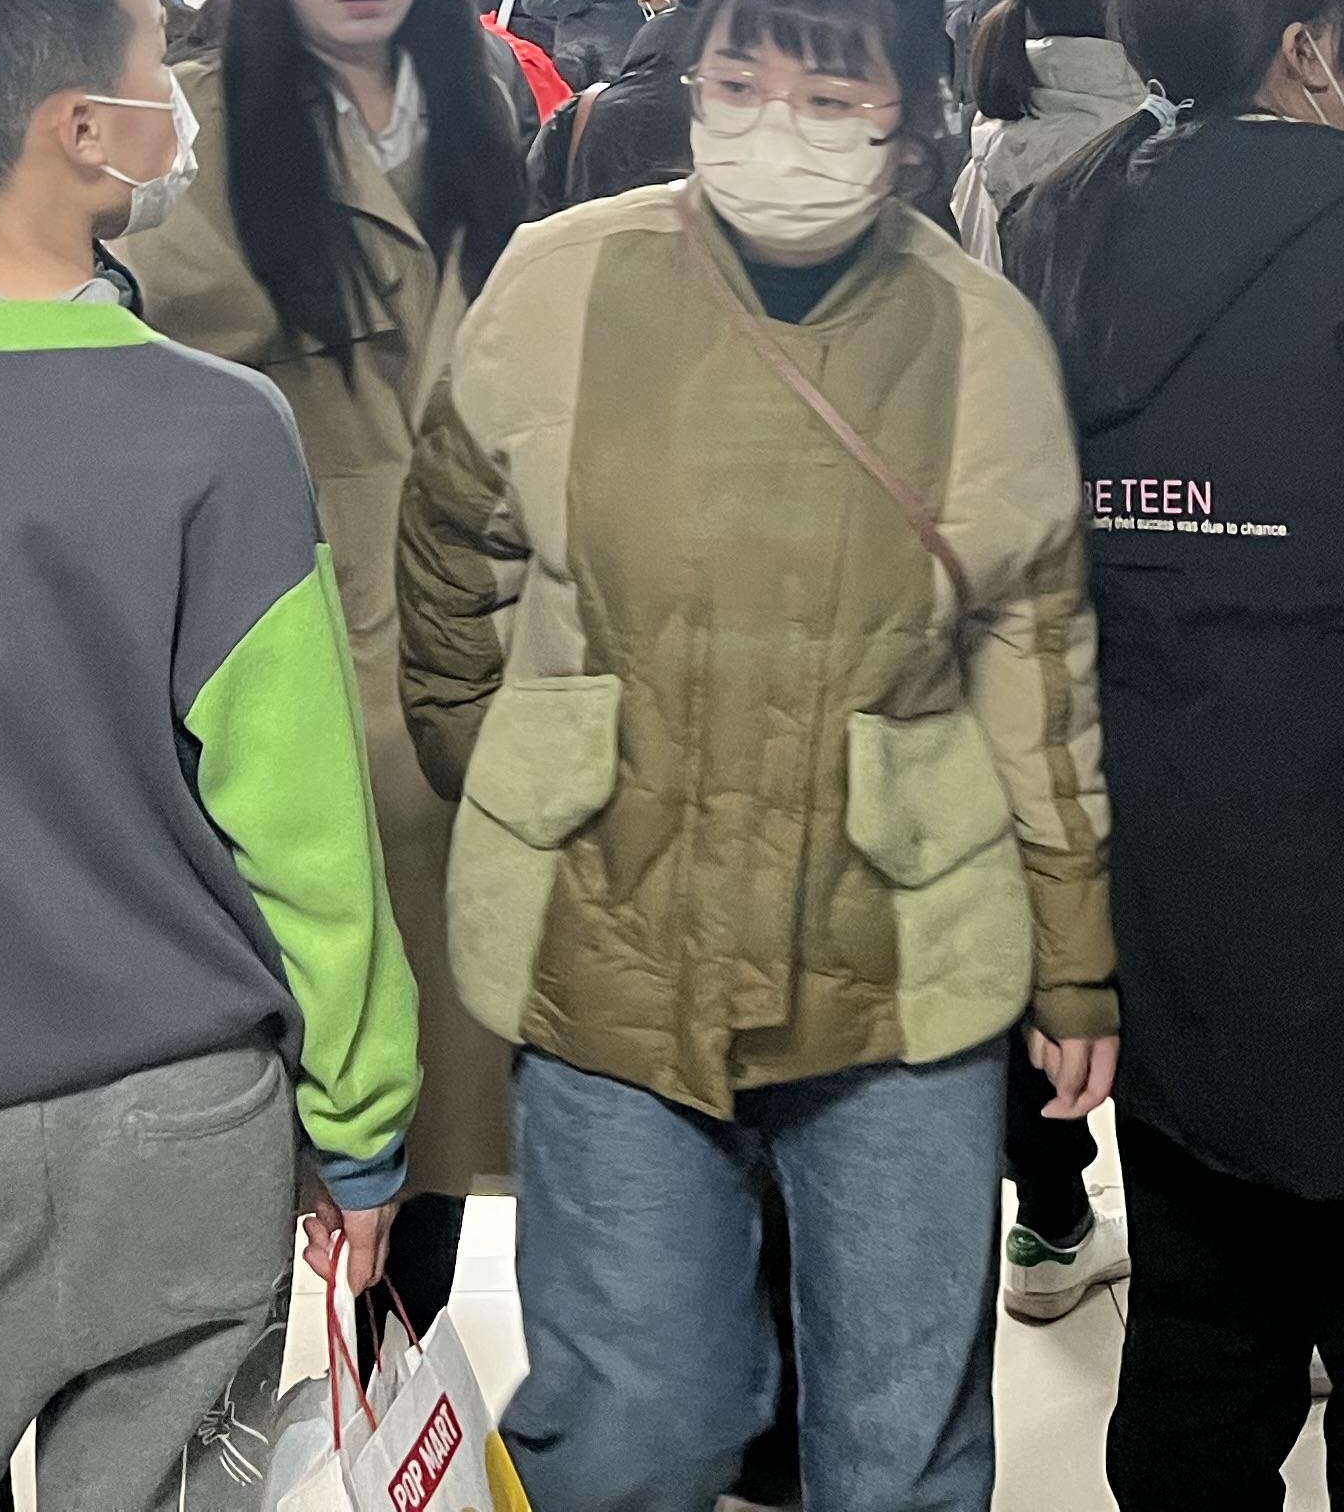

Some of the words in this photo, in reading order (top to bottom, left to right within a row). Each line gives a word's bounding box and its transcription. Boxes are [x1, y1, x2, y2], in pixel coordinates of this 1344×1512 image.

[1121, 479, 1212, 515] TEEN
[1201, 519, 1224, 534] due
[1226, 522, 1238, 535] to
[393, 1460, 425, 1512] POP
[418, 1403, 458, 1480] MART
